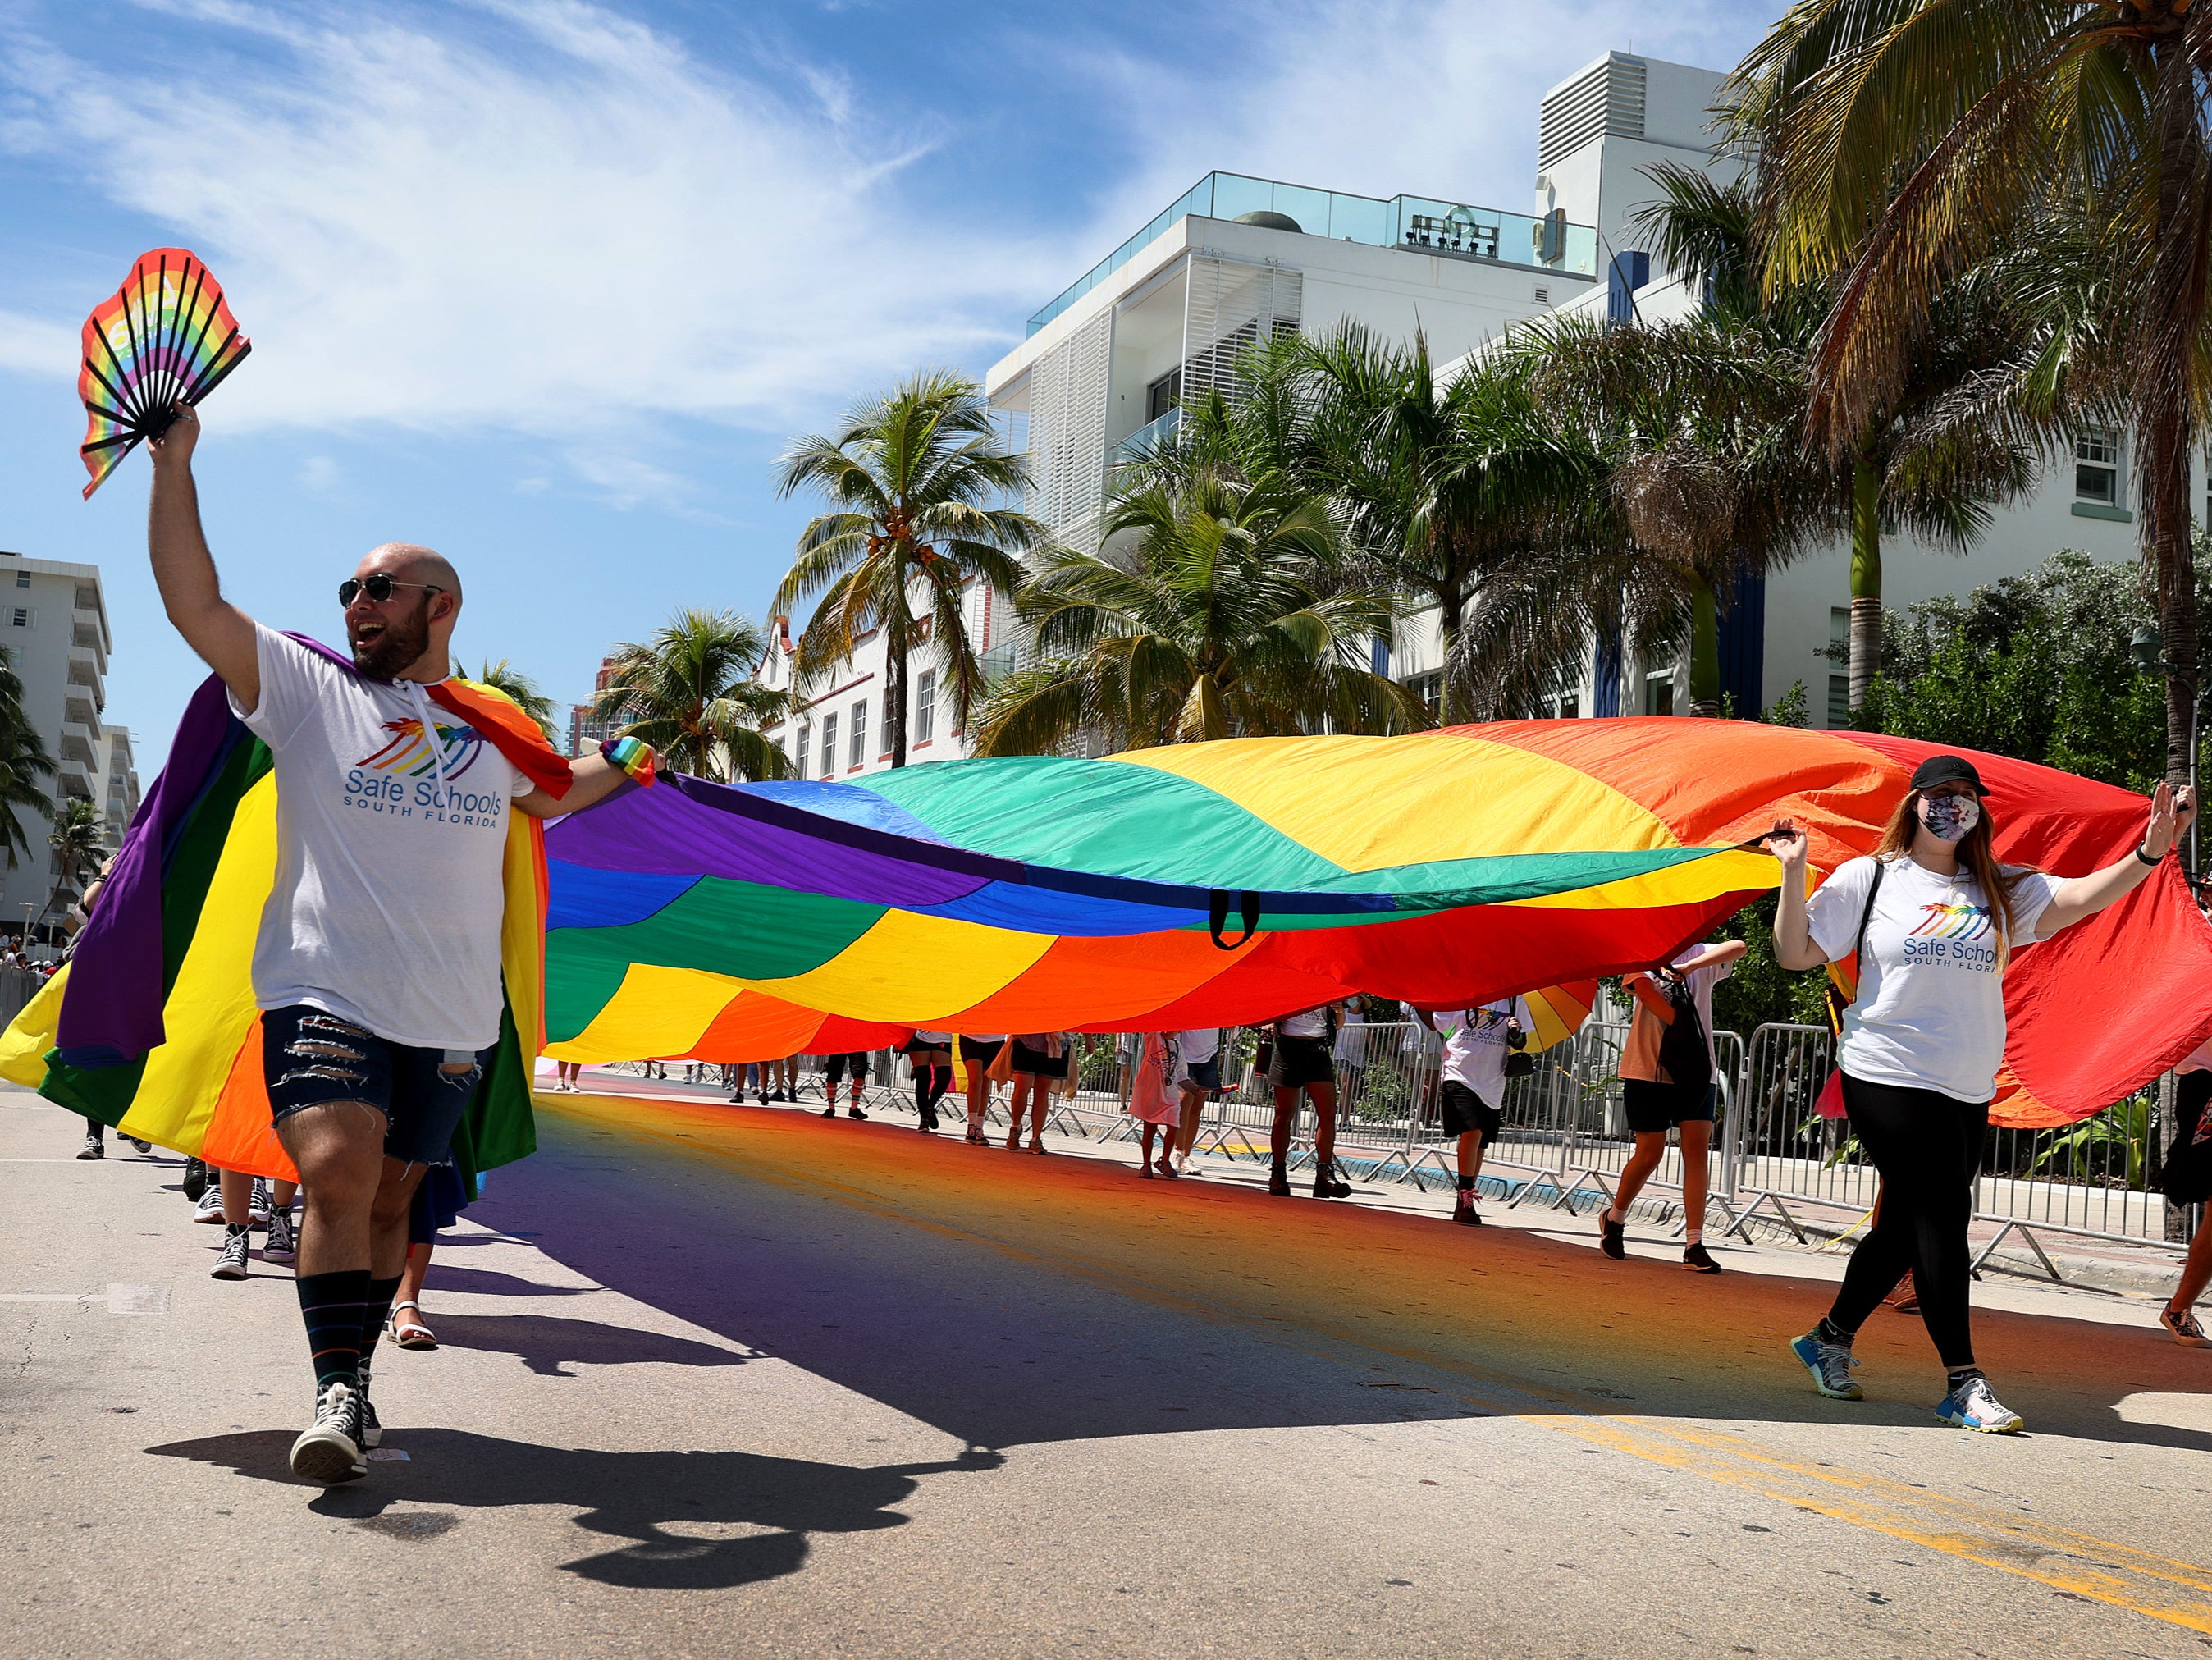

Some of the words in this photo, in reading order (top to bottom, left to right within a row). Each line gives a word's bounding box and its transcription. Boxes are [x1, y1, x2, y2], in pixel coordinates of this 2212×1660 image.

[345, 770, 404, 802] Safe
[414, 781, 502, 816] Schools
[343, 796, 412, 817] SOUTH
[425, 811, 496, 828] FLORIDA
[1904, 938, 1946, 957] Safe
[1952, 942, 1997, 964] Scho
[1904, 958, 1951, 967] SOUTH
[1958, 962, 1995, 973] FLORI
